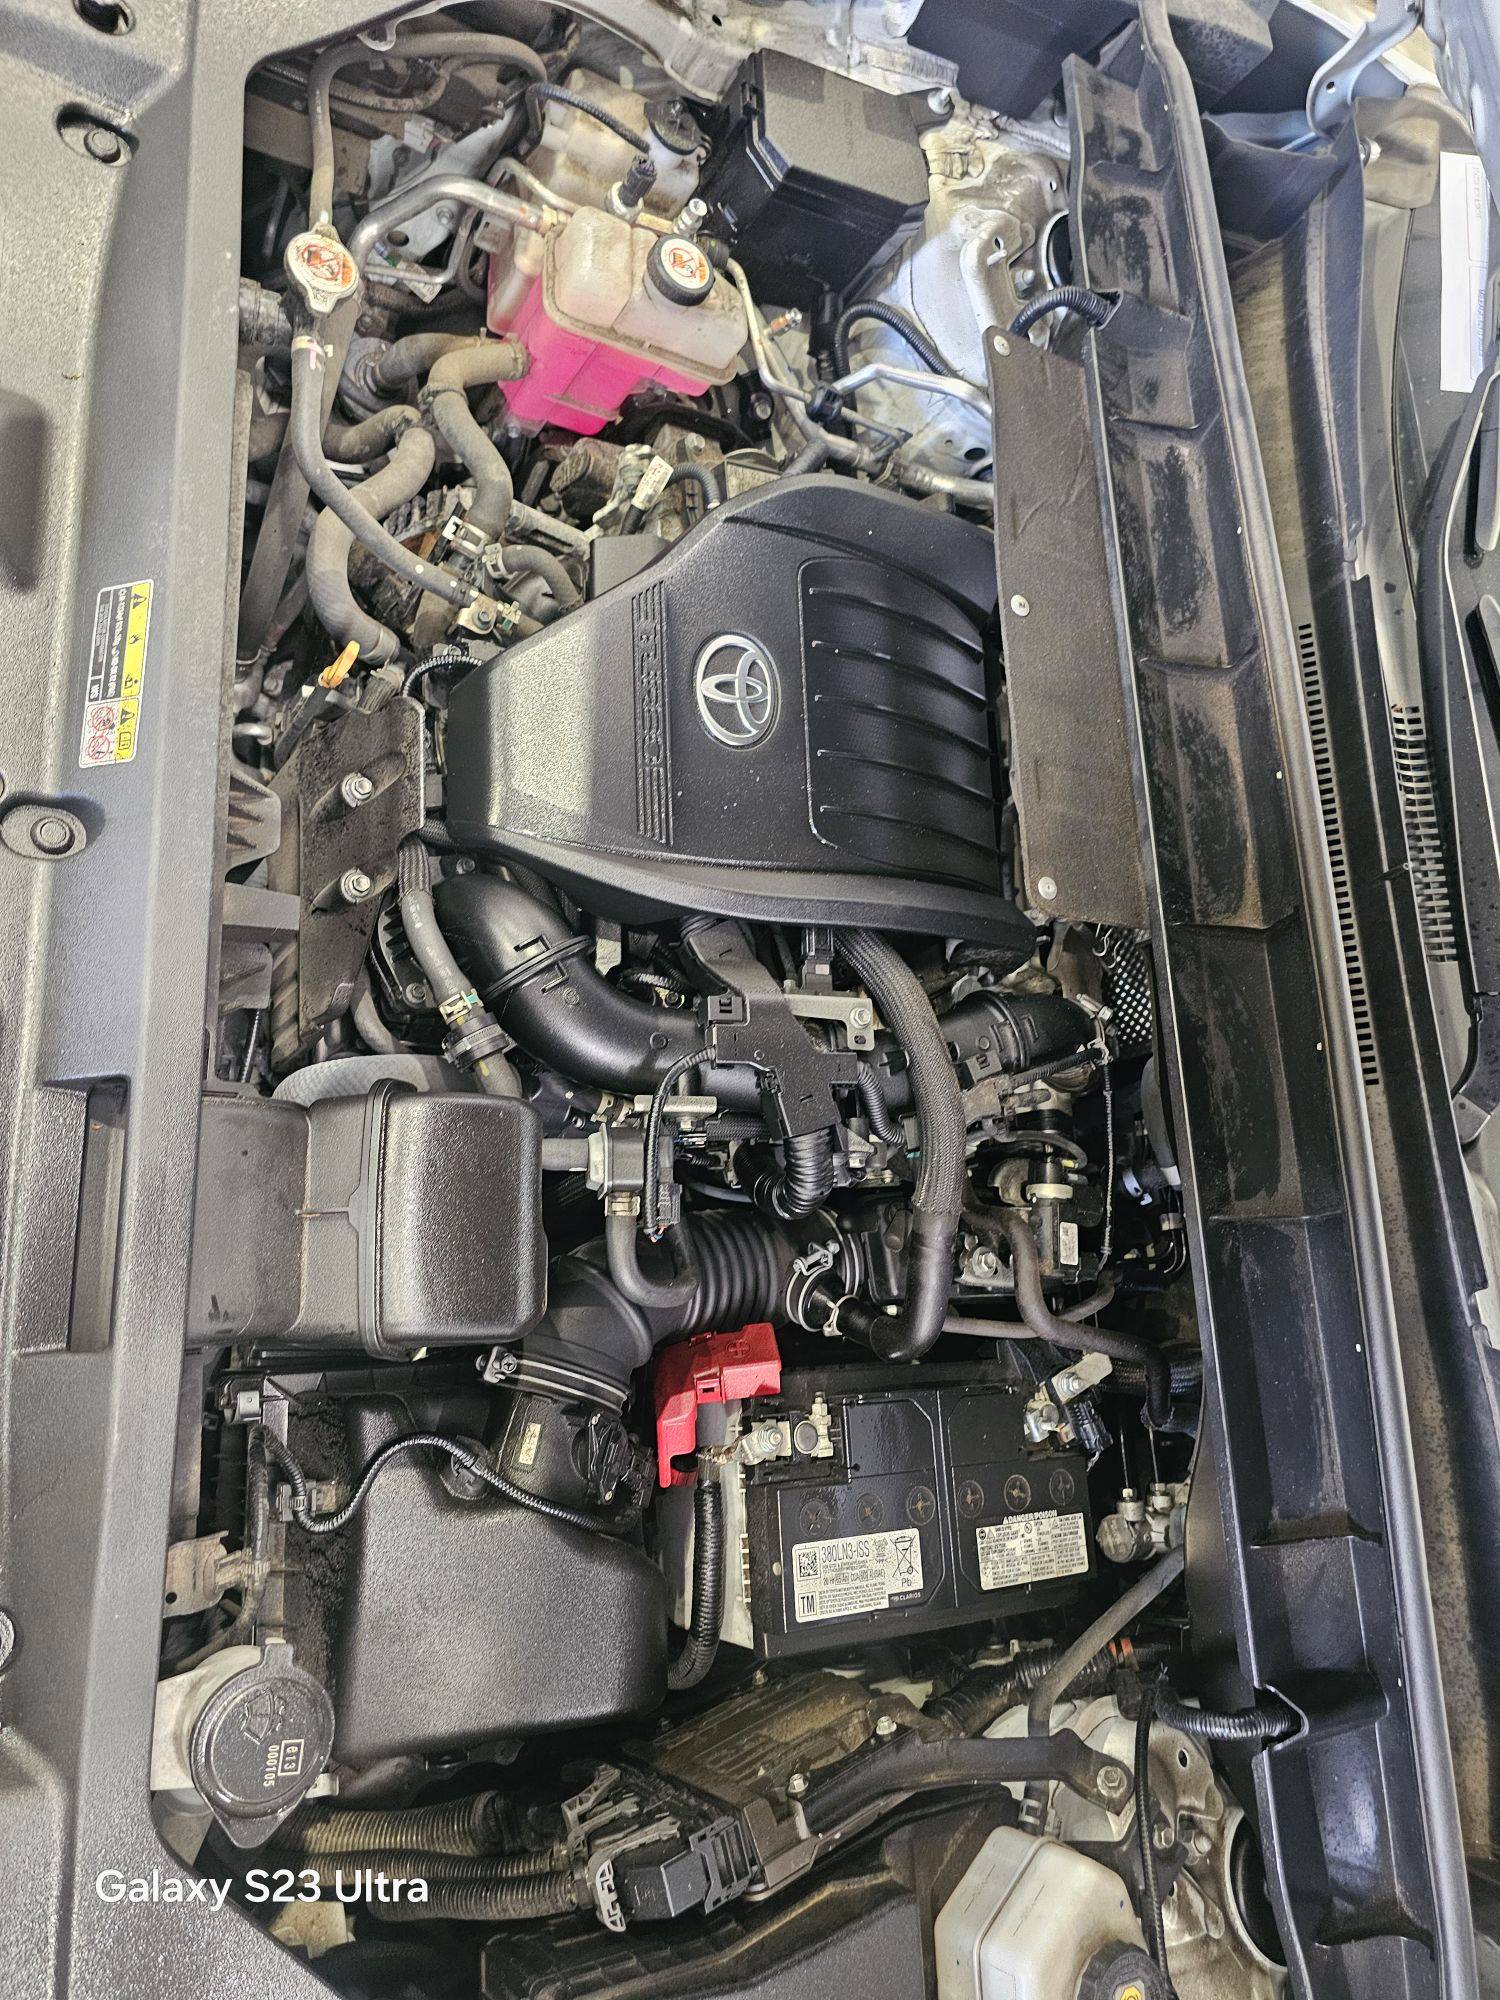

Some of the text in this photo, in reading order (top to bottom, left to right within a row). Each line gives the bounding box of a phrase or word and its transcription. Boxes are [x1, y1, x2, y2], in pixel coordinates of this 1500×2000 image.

[821, 1540, 870, 1563] 380LN3-ISS
[901, 1577, 913, 1588] Pb
[800, 1594, 815, 1614] TM
[899, 1592, 921, 1601] CLARIOS
[262, 1744, 280, 1788] 000105
